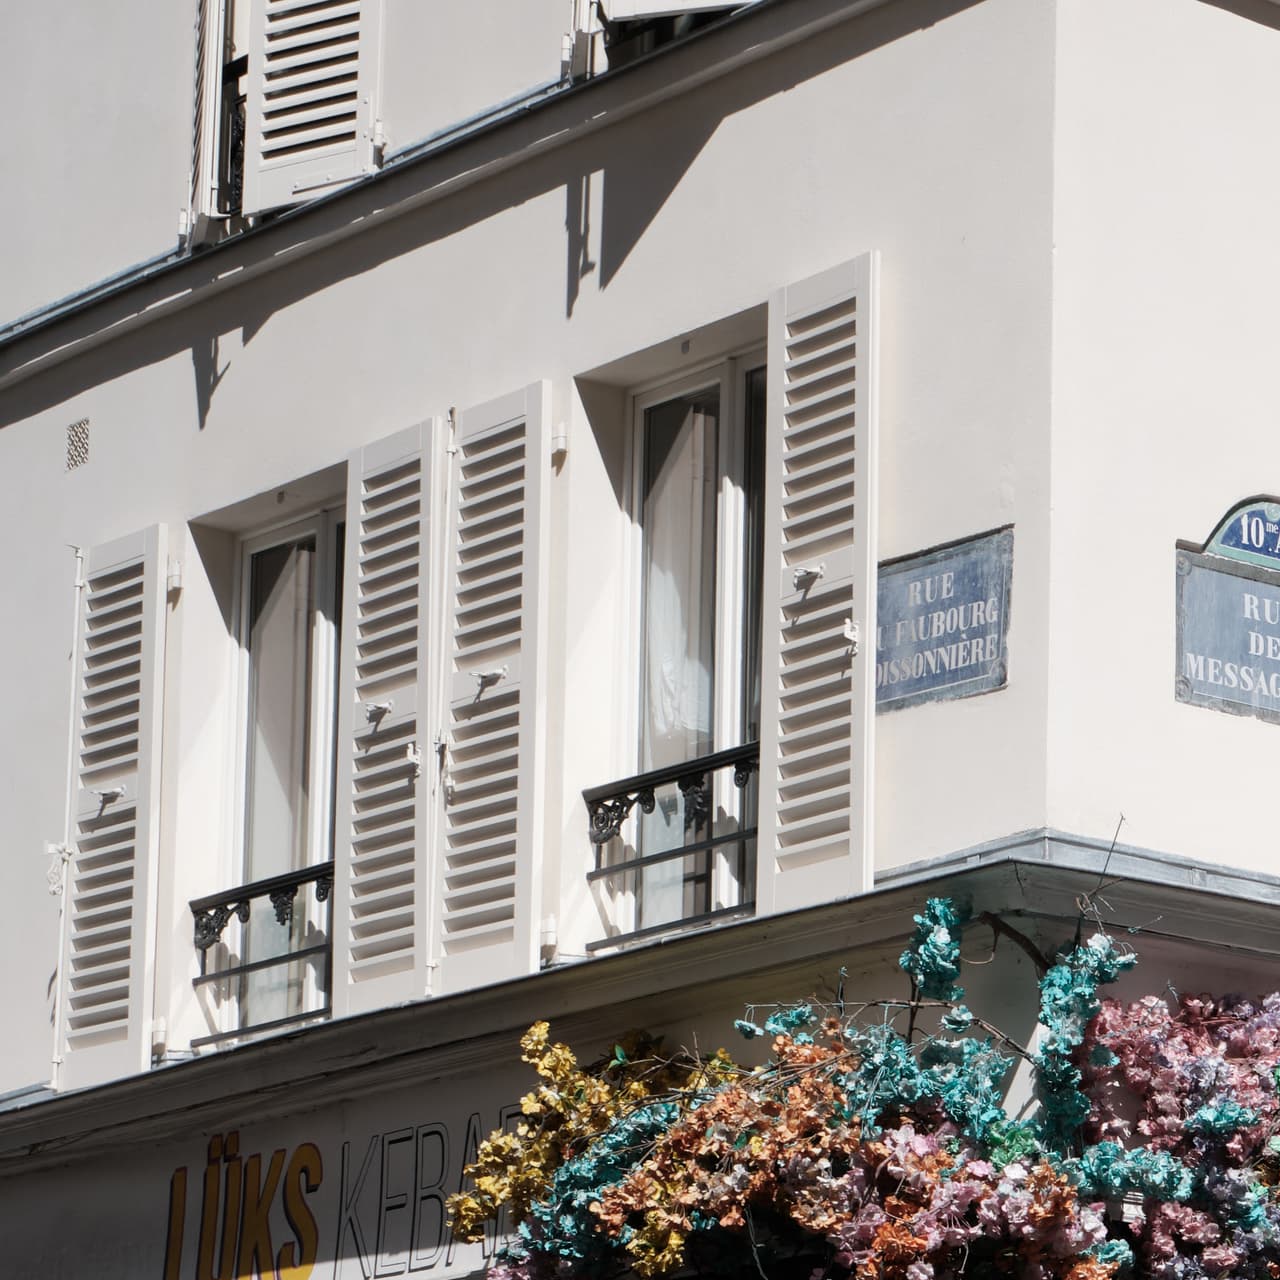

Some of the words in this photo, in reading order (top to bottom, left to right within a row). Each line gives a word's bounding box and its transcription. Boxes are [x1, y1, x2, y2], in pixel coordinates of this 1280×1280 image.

[908, 571, 955, 607] RUE
[876, 624, 889, 651] U
[895, 597, 999, 646] FAUBOURG
[875, 632, 999, 690] OISSONNIÈRE
